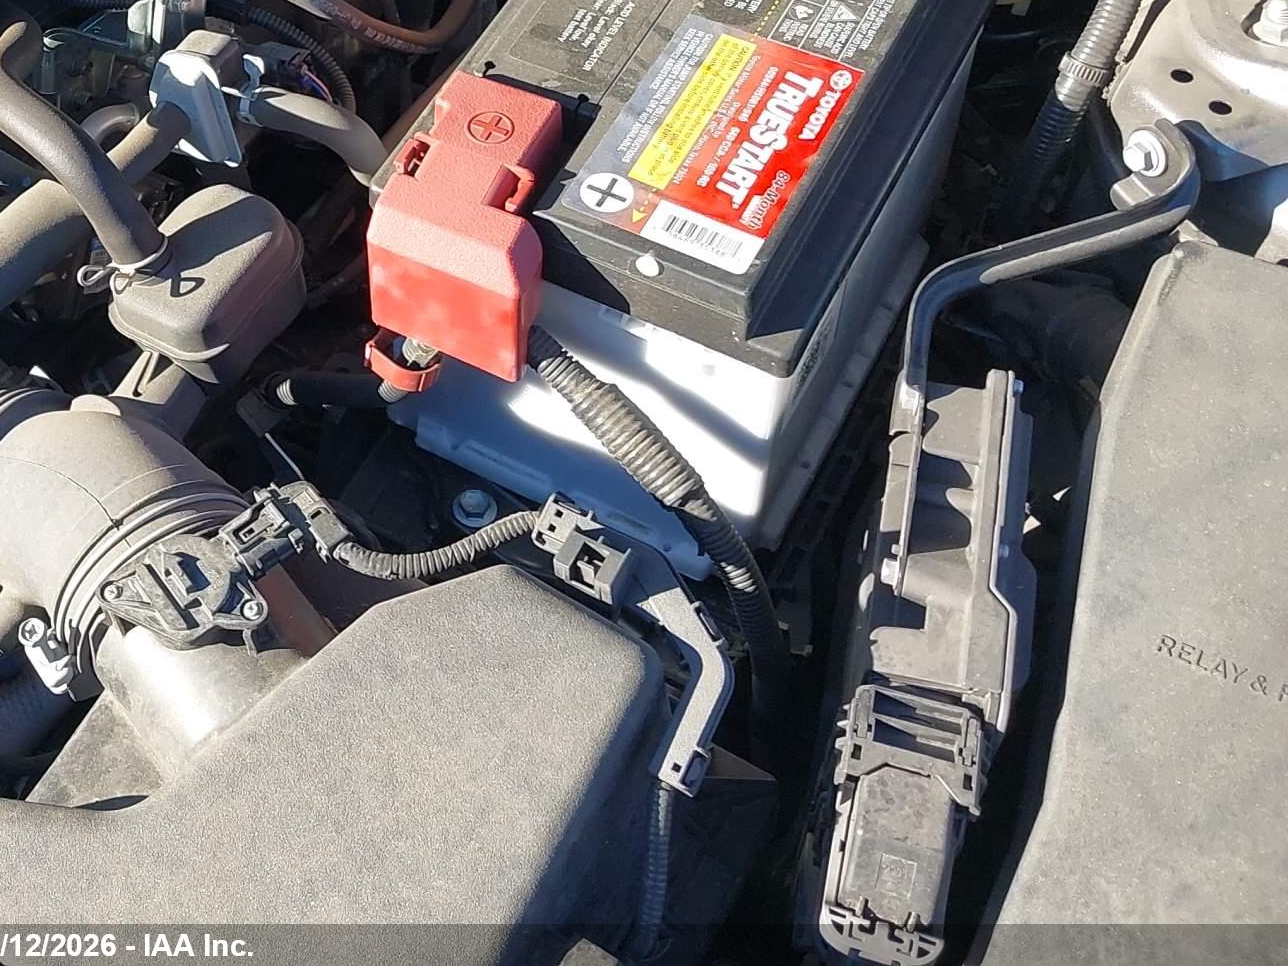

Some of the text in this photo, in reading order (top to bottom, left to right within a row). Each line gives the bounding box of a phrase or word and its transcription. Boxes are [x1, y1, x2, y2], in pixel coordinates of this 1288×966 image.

[579, 11, 596, 29] Level
[734, 1, 746, 9] BE
[557, 20, 578, 42] battery
[582, 1, 634, 70] ACID LEVEL INDICATOR
[592, 16, 609, 33] Level
[798, 90, 842, 141] TOYOTA
[745, 169, 789, 229] 84-Month
[1157, 634, 1249, 684] RELAY
[1249, 674, 1268, 696] &
